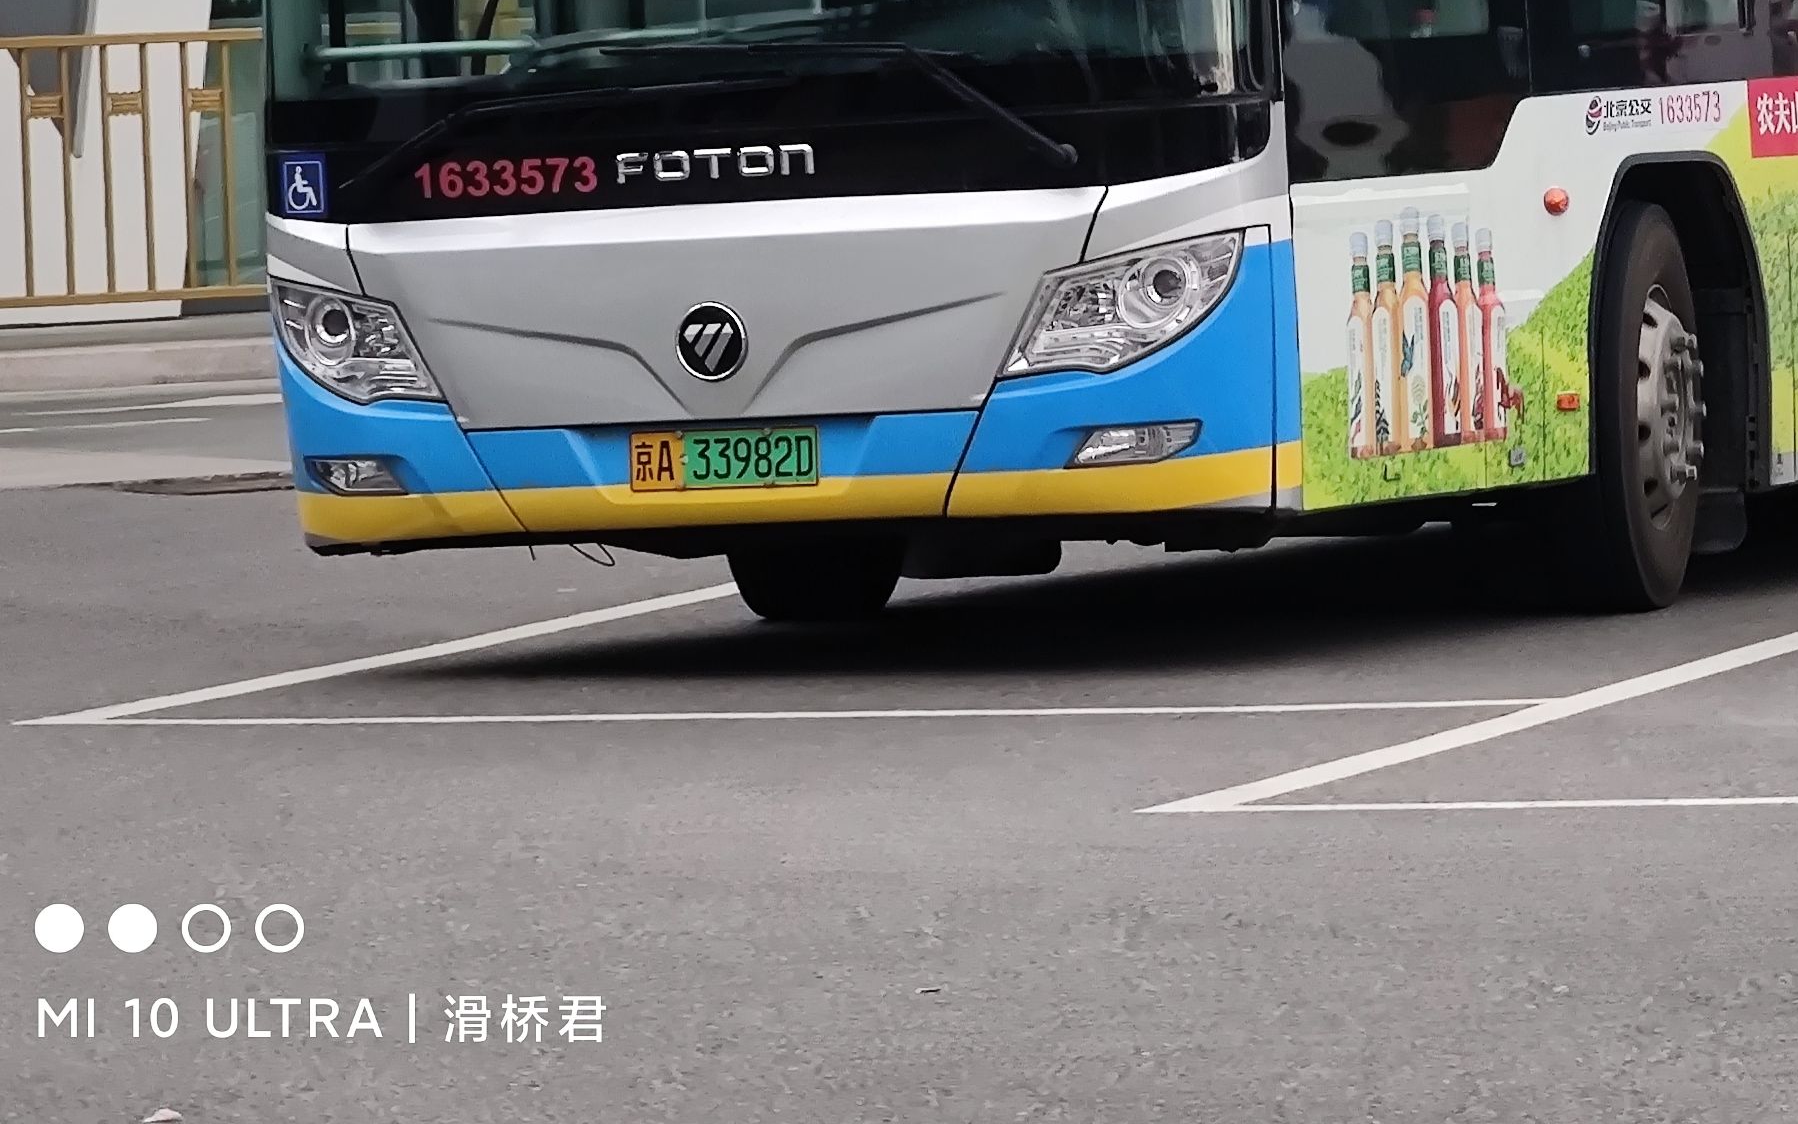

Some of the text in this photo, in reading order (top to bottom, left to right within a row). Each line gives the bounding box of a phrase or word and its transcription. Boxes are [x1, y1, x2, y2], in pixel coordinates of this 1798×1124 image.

[1602, 90, 1722, 126] 北京公交 1633573
[414, 143, 815, 199] 1633573 FOTON
[634, 435, 814, 482] 京A 33982D
